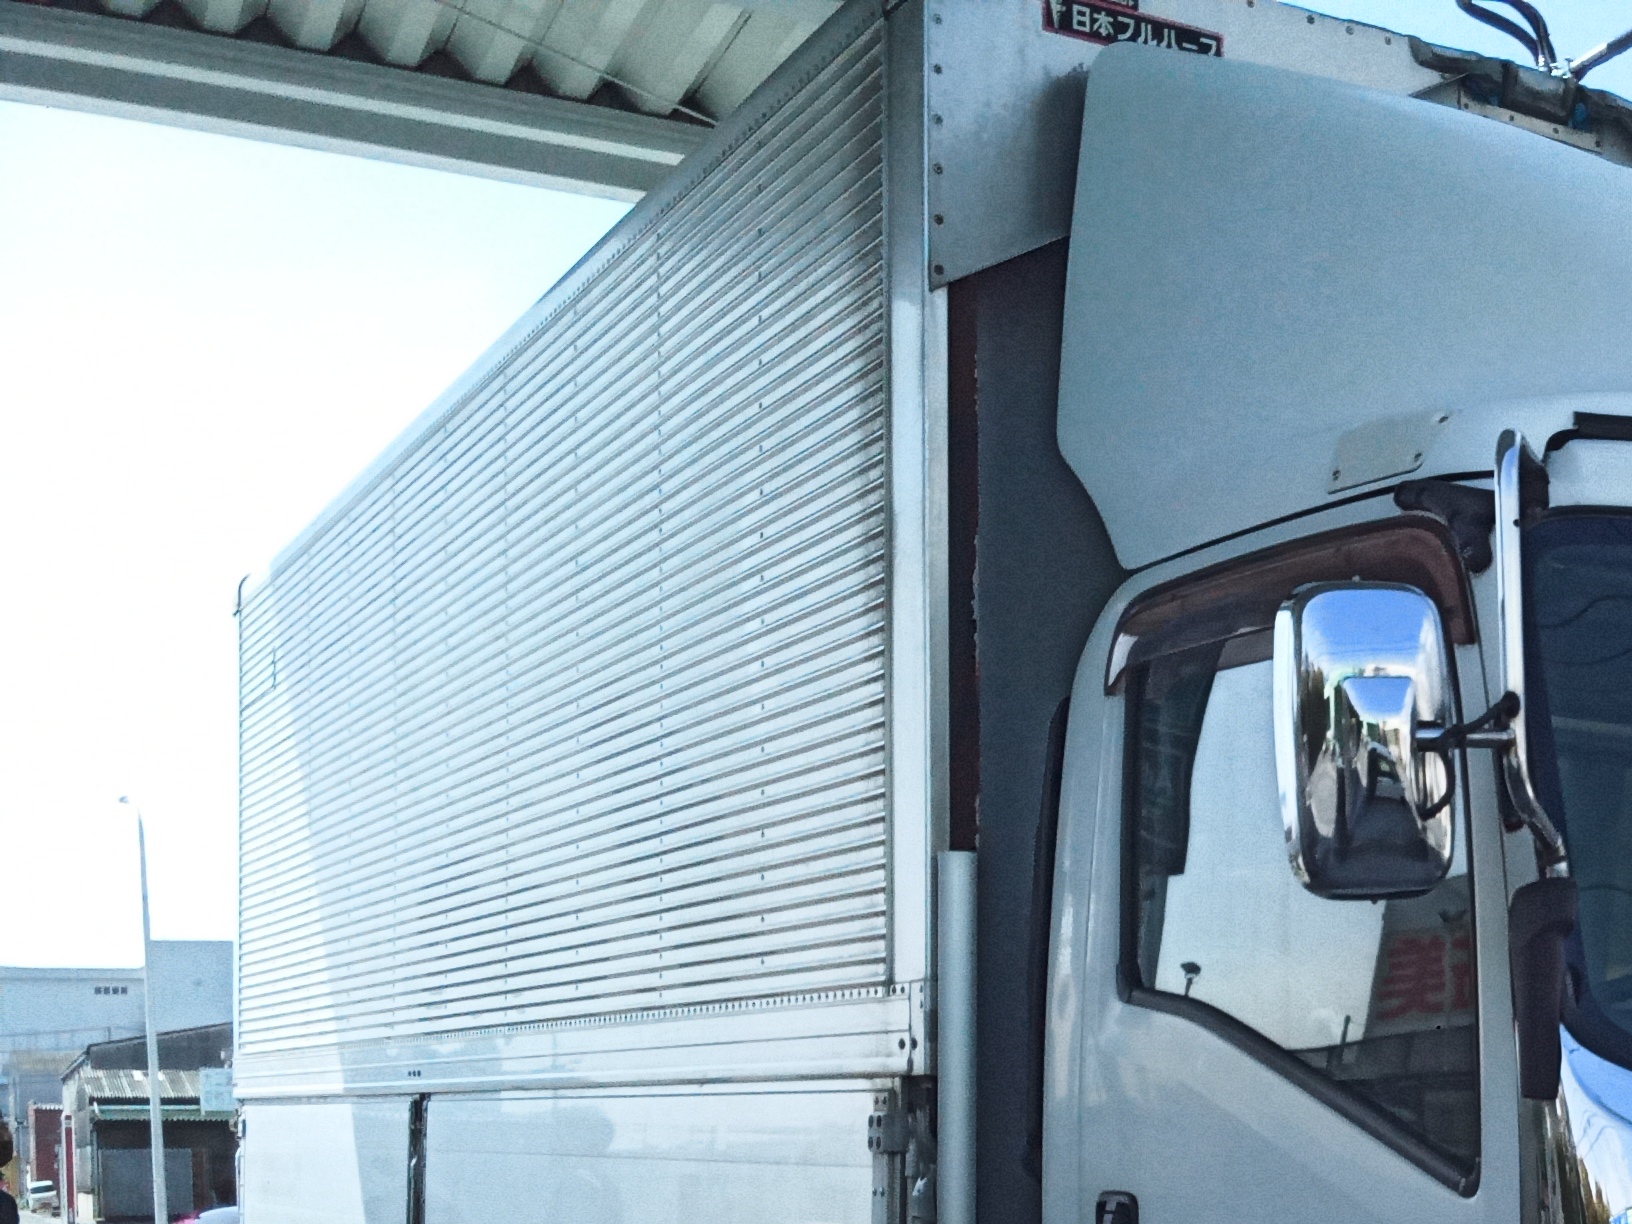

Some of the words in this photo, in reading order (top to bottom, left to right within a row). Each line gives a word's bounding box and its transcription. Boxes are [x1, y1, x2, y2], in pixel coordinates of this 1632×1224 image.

[1072, 4, 1217, 57] 日本フルハーフ
